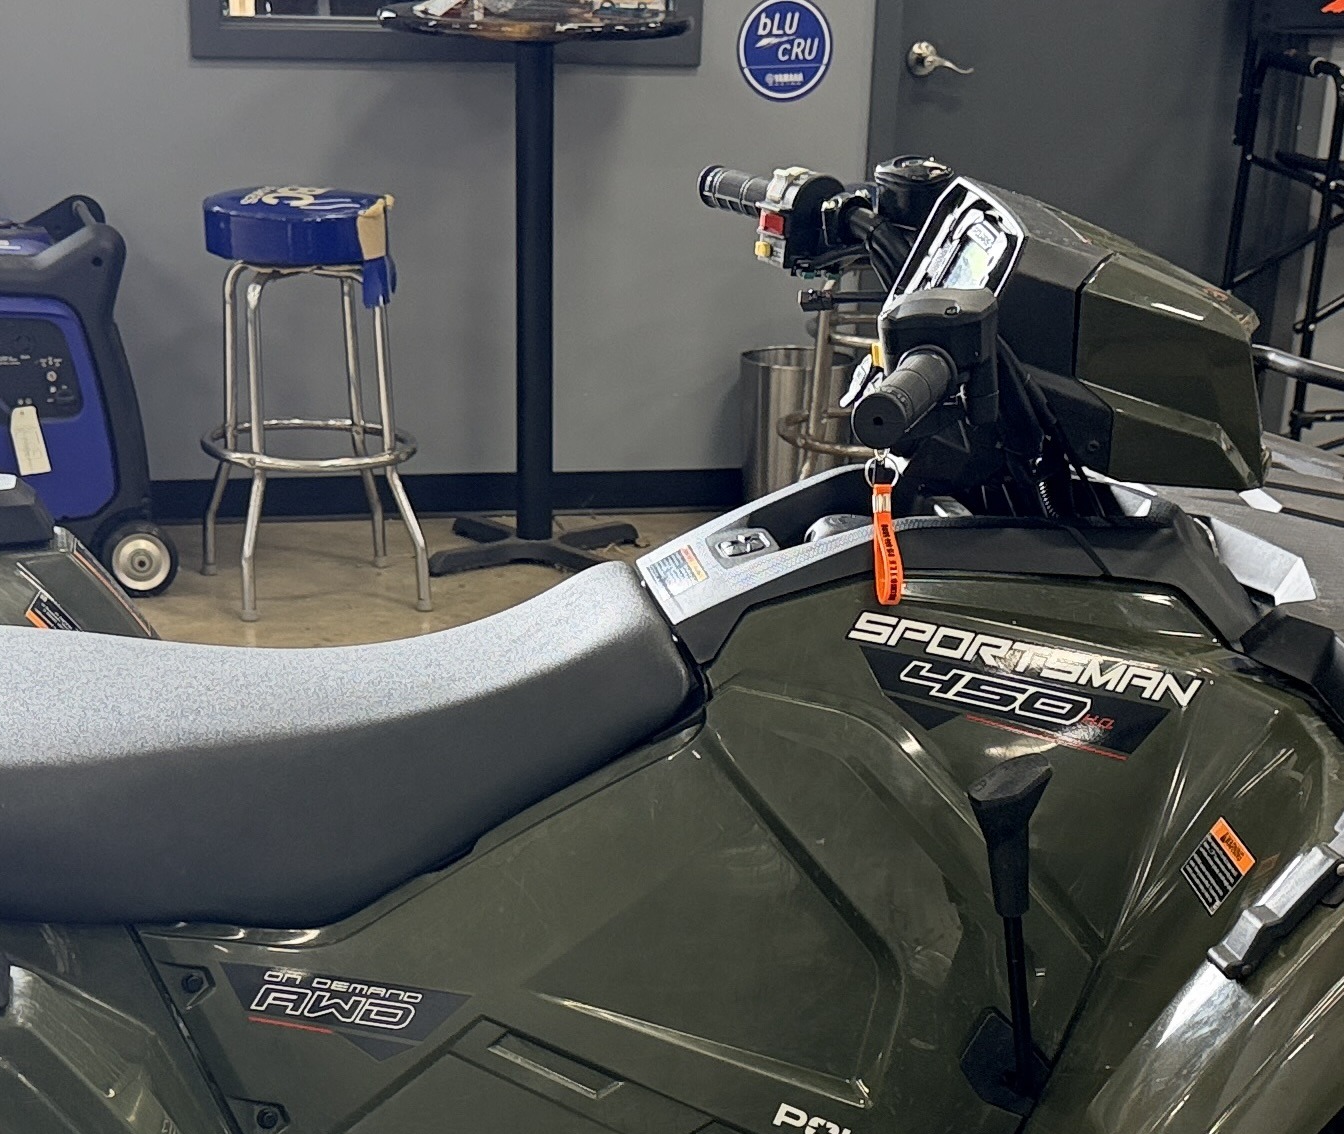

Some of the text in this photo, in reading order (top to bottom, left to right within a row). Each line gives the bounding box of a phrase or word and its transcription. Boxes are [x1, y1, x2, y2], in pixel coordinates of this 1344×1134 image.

[847, 611, 1203, 707] SPORTSMAN
[900, 660, 1092, 726] 450
[250, 984, 416, 1030] AWD
[264, 970, 423, 1003] ON DEMAND
